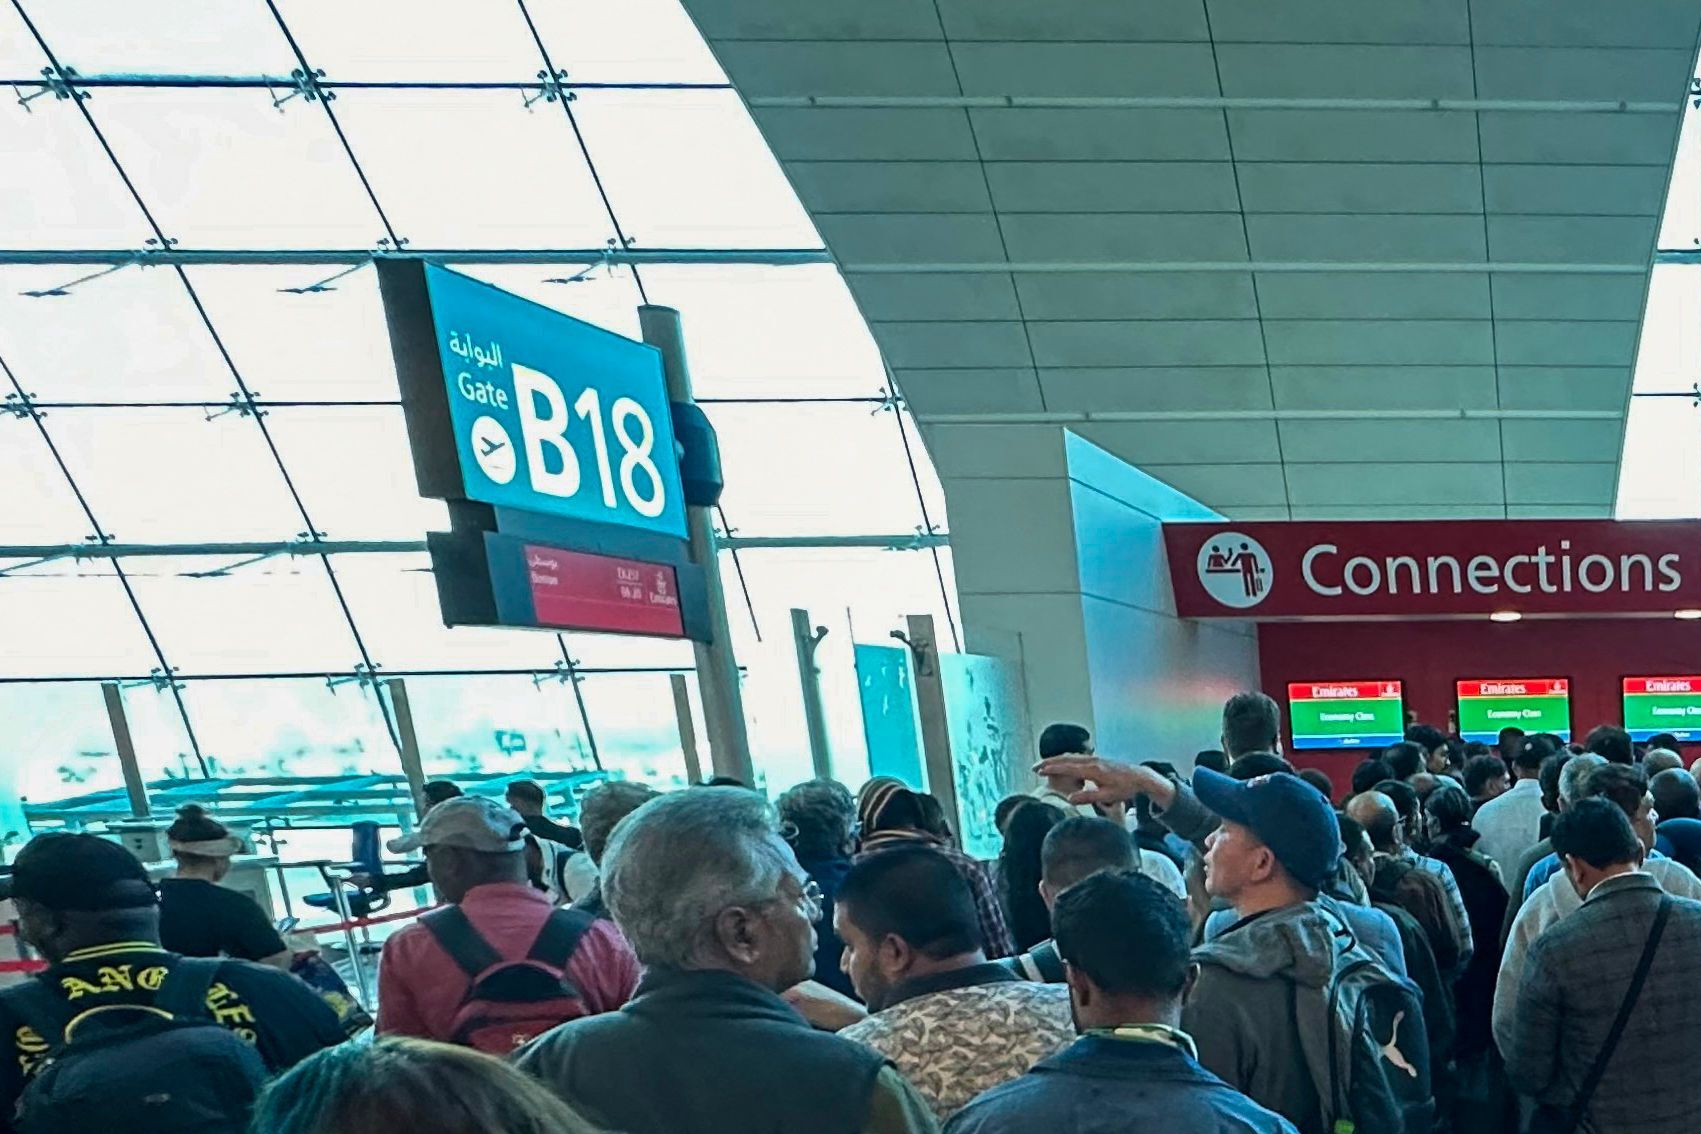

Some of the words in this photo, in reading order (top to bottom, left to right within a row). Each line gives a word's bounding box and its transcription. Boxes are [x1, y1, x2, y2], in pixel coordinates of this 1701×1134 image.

[449, 330, 504, 369] البوابة
[458, 371, 509, 411] Gate
[511, 363, 666, 518] B18
[1301, 539, 1682, 596] Connections
[1312, 686, 1359, 698] Emirates
[1480, 684, 1526, 695] Emirates
[1645, 680, 1692, 691] Emirates
